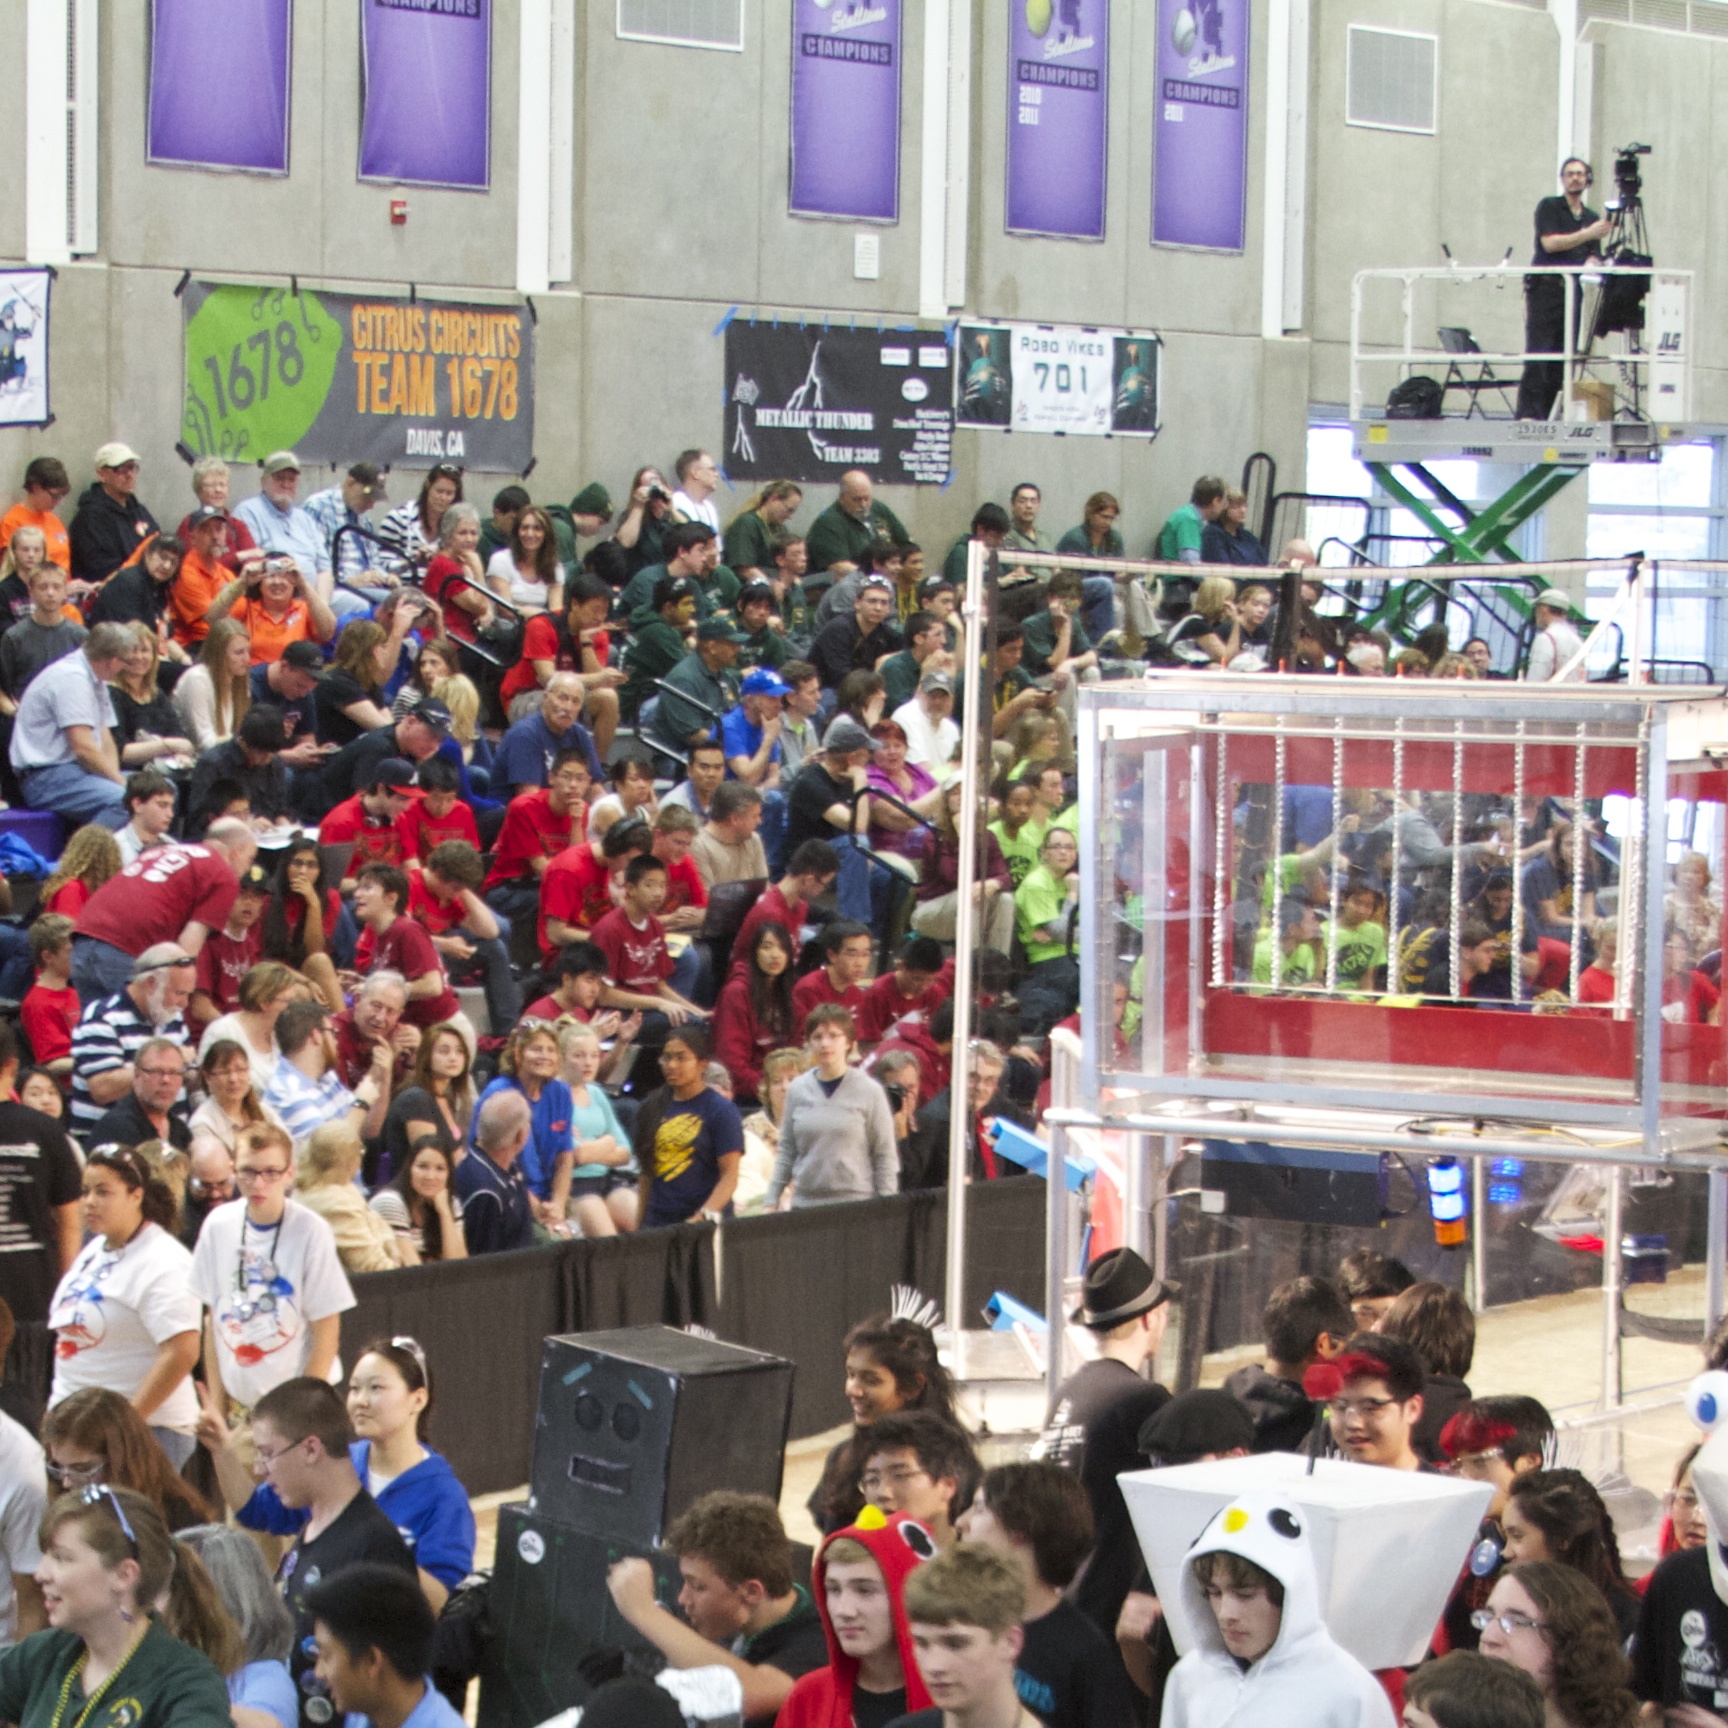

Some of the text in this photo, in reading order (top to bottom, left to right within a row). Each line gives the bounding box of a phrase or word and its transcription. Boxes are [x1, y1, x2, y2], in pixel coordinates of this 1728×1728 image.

[351, 304, 520, 357] CITRUS CIRCUITS
[204, 320, 305, 420] 1678
[352, 351, 519, 420] TEAM 1678
[1033, 362, 1087, 394] 701
[756, 408, 874, 430] METALLIC THUNDER
[446, 431, 466, 457] CA
[823, 446, 853, 463] TEAM
